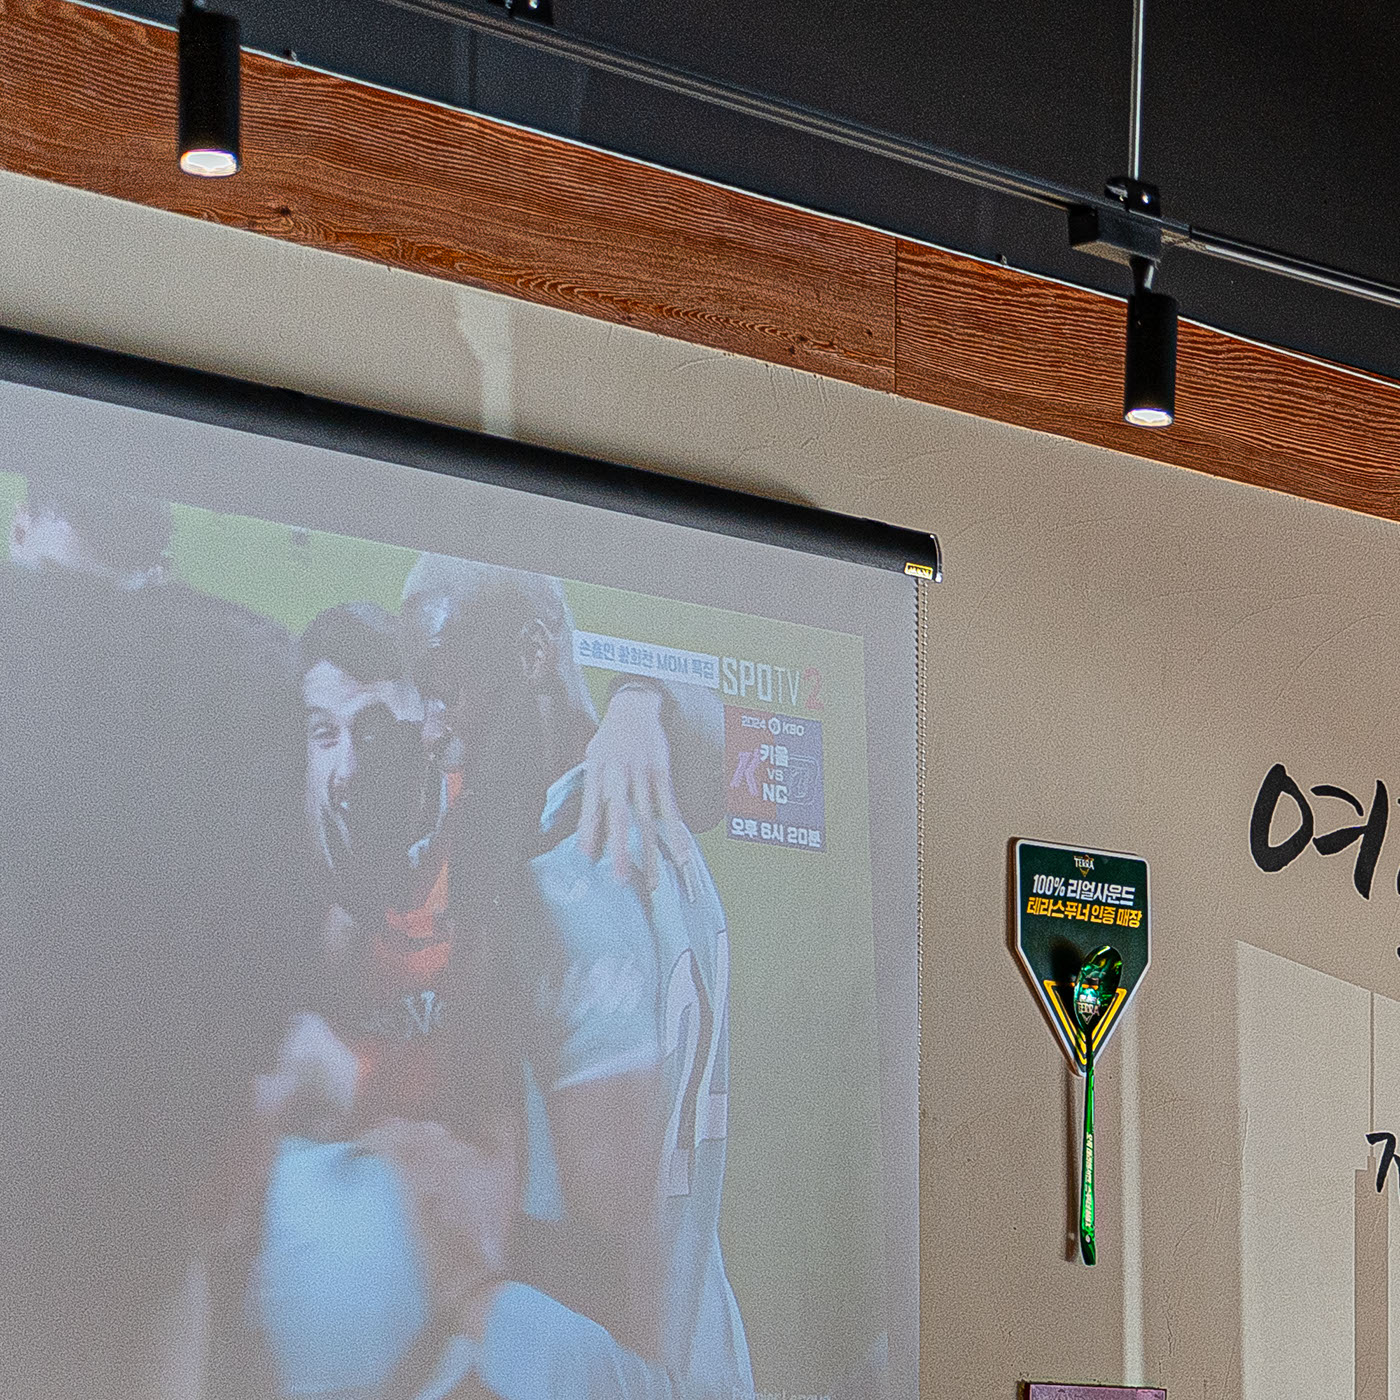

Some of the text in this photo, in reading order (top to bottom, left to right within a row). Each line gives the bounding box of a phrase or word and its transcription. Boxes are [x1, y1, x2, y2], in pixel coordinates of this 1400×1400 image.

[656, 653, 688, 675] MOM
[782, 720, 805, 736] KBO
[759, 743, 788, 767] 키움
[731, 817, 758, 839] 오후
[1074, 857, 1095, 870] TERRA
[1032, 874, 1136, 907] 100% 리얼사운드
[1026, 897, 1143, 929] 테라스푸너 인증 매장
